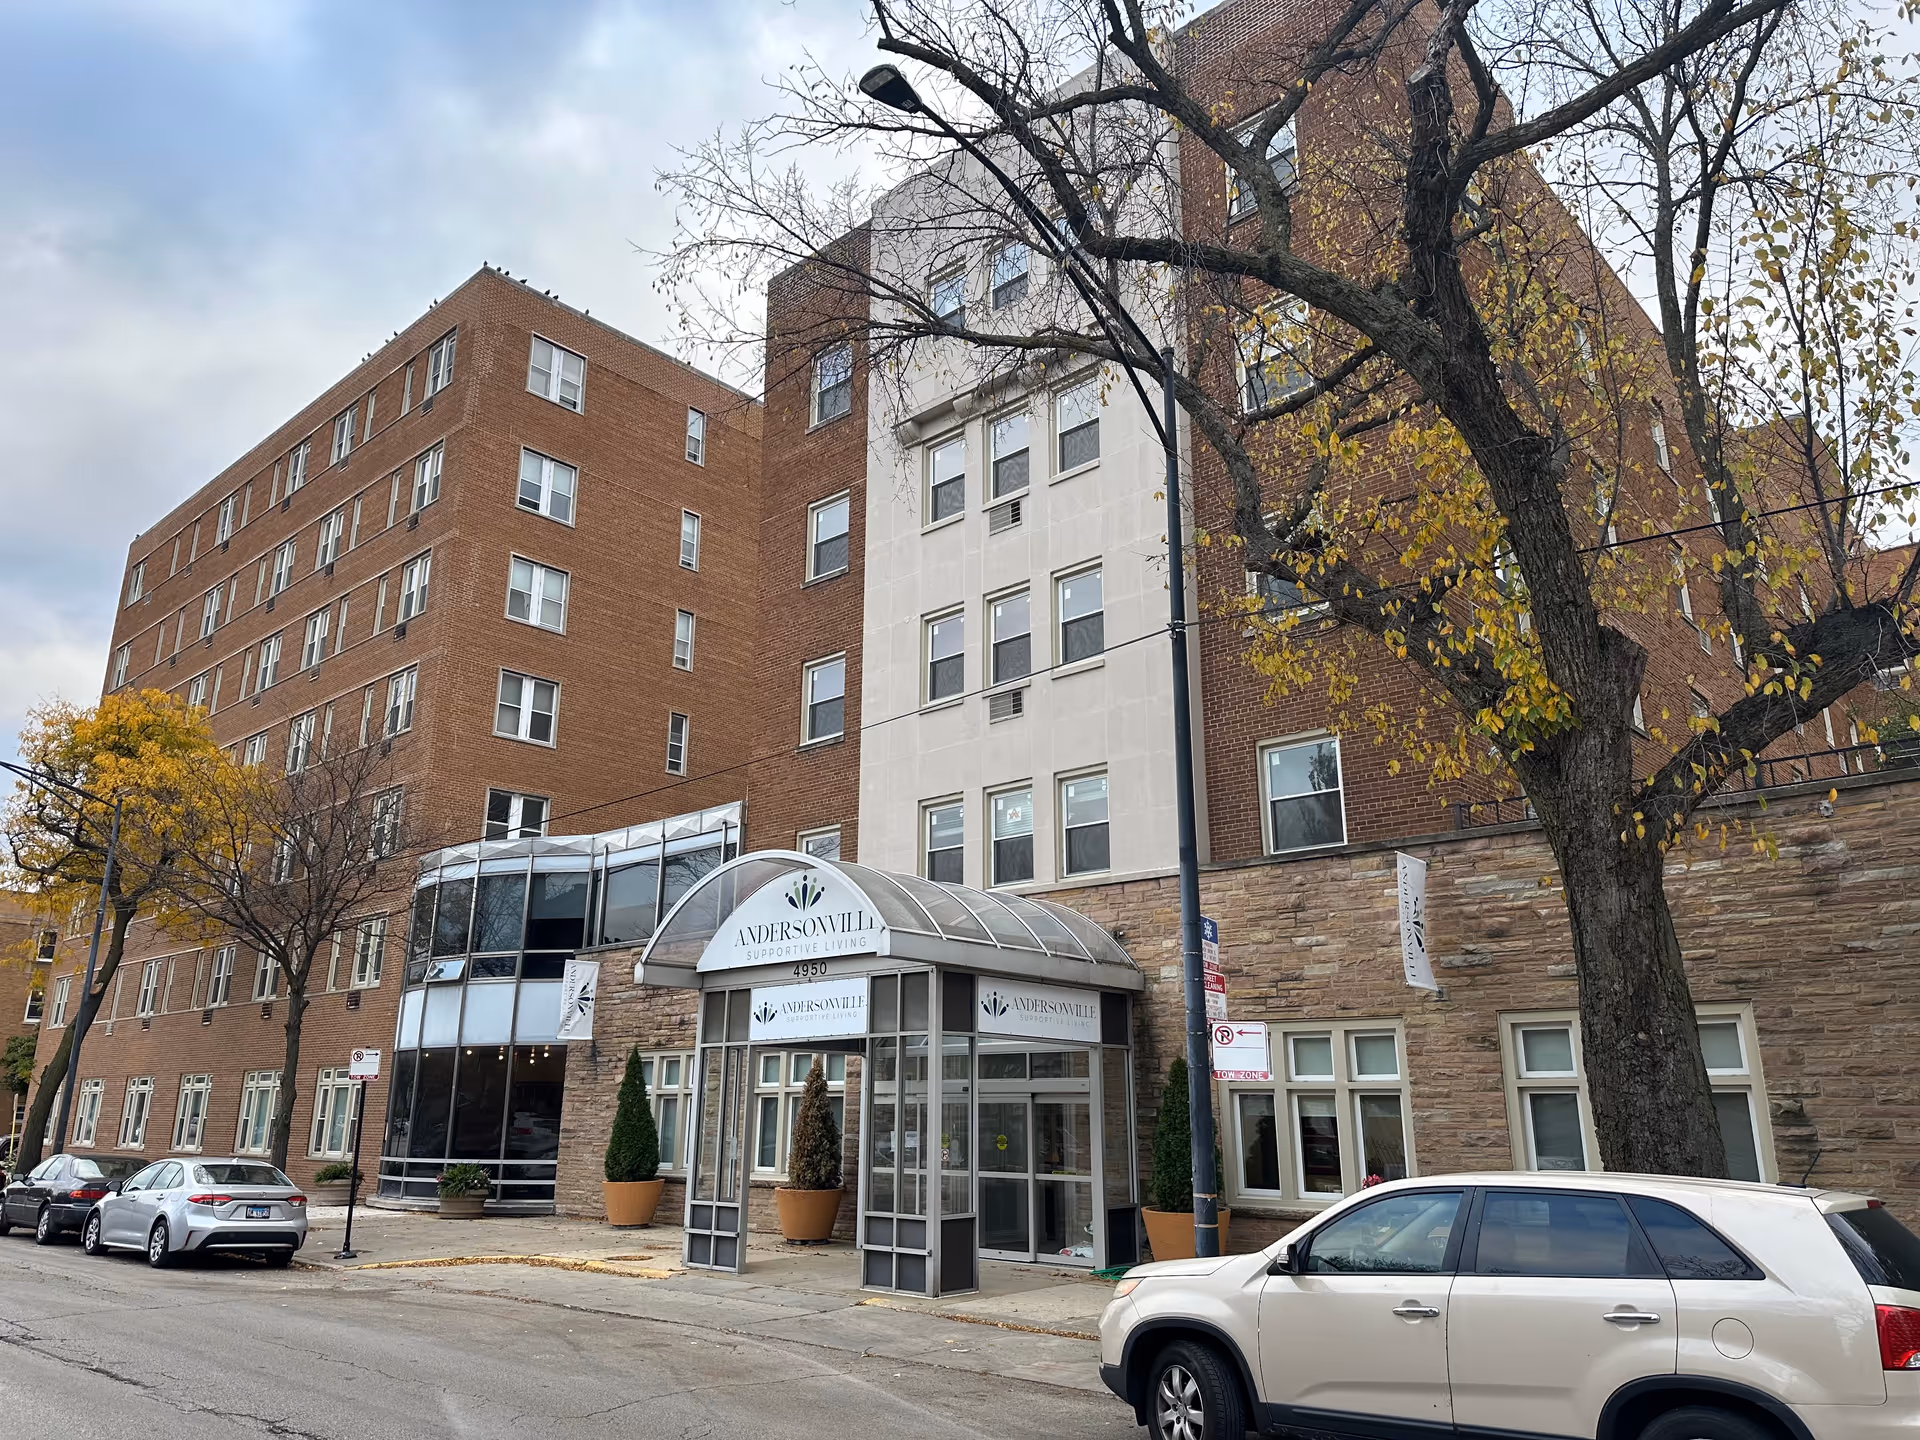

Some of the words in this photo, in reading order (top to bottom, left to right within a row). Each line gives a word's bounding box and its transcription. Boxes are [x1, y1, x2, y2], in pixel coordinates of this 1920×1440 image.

[747, 942, 818, 961] SUPPORTIVE
[825, 937, 867, 951] LIVING
[793, 961, 827, 978] 4950
[780, 995, 866, 1015] ANDERSONVILLE
[1011, 997, 1097, 1019] ANDERSONVILLE
[786, 1014, 829, 1023] SUPPORTIVE
[833, 1011, 858, 1020] LIVING
[1020, 1015, 1064, 1025] SUPPORTIVE
[1240, 1071, 1264, 1079] ZONE
